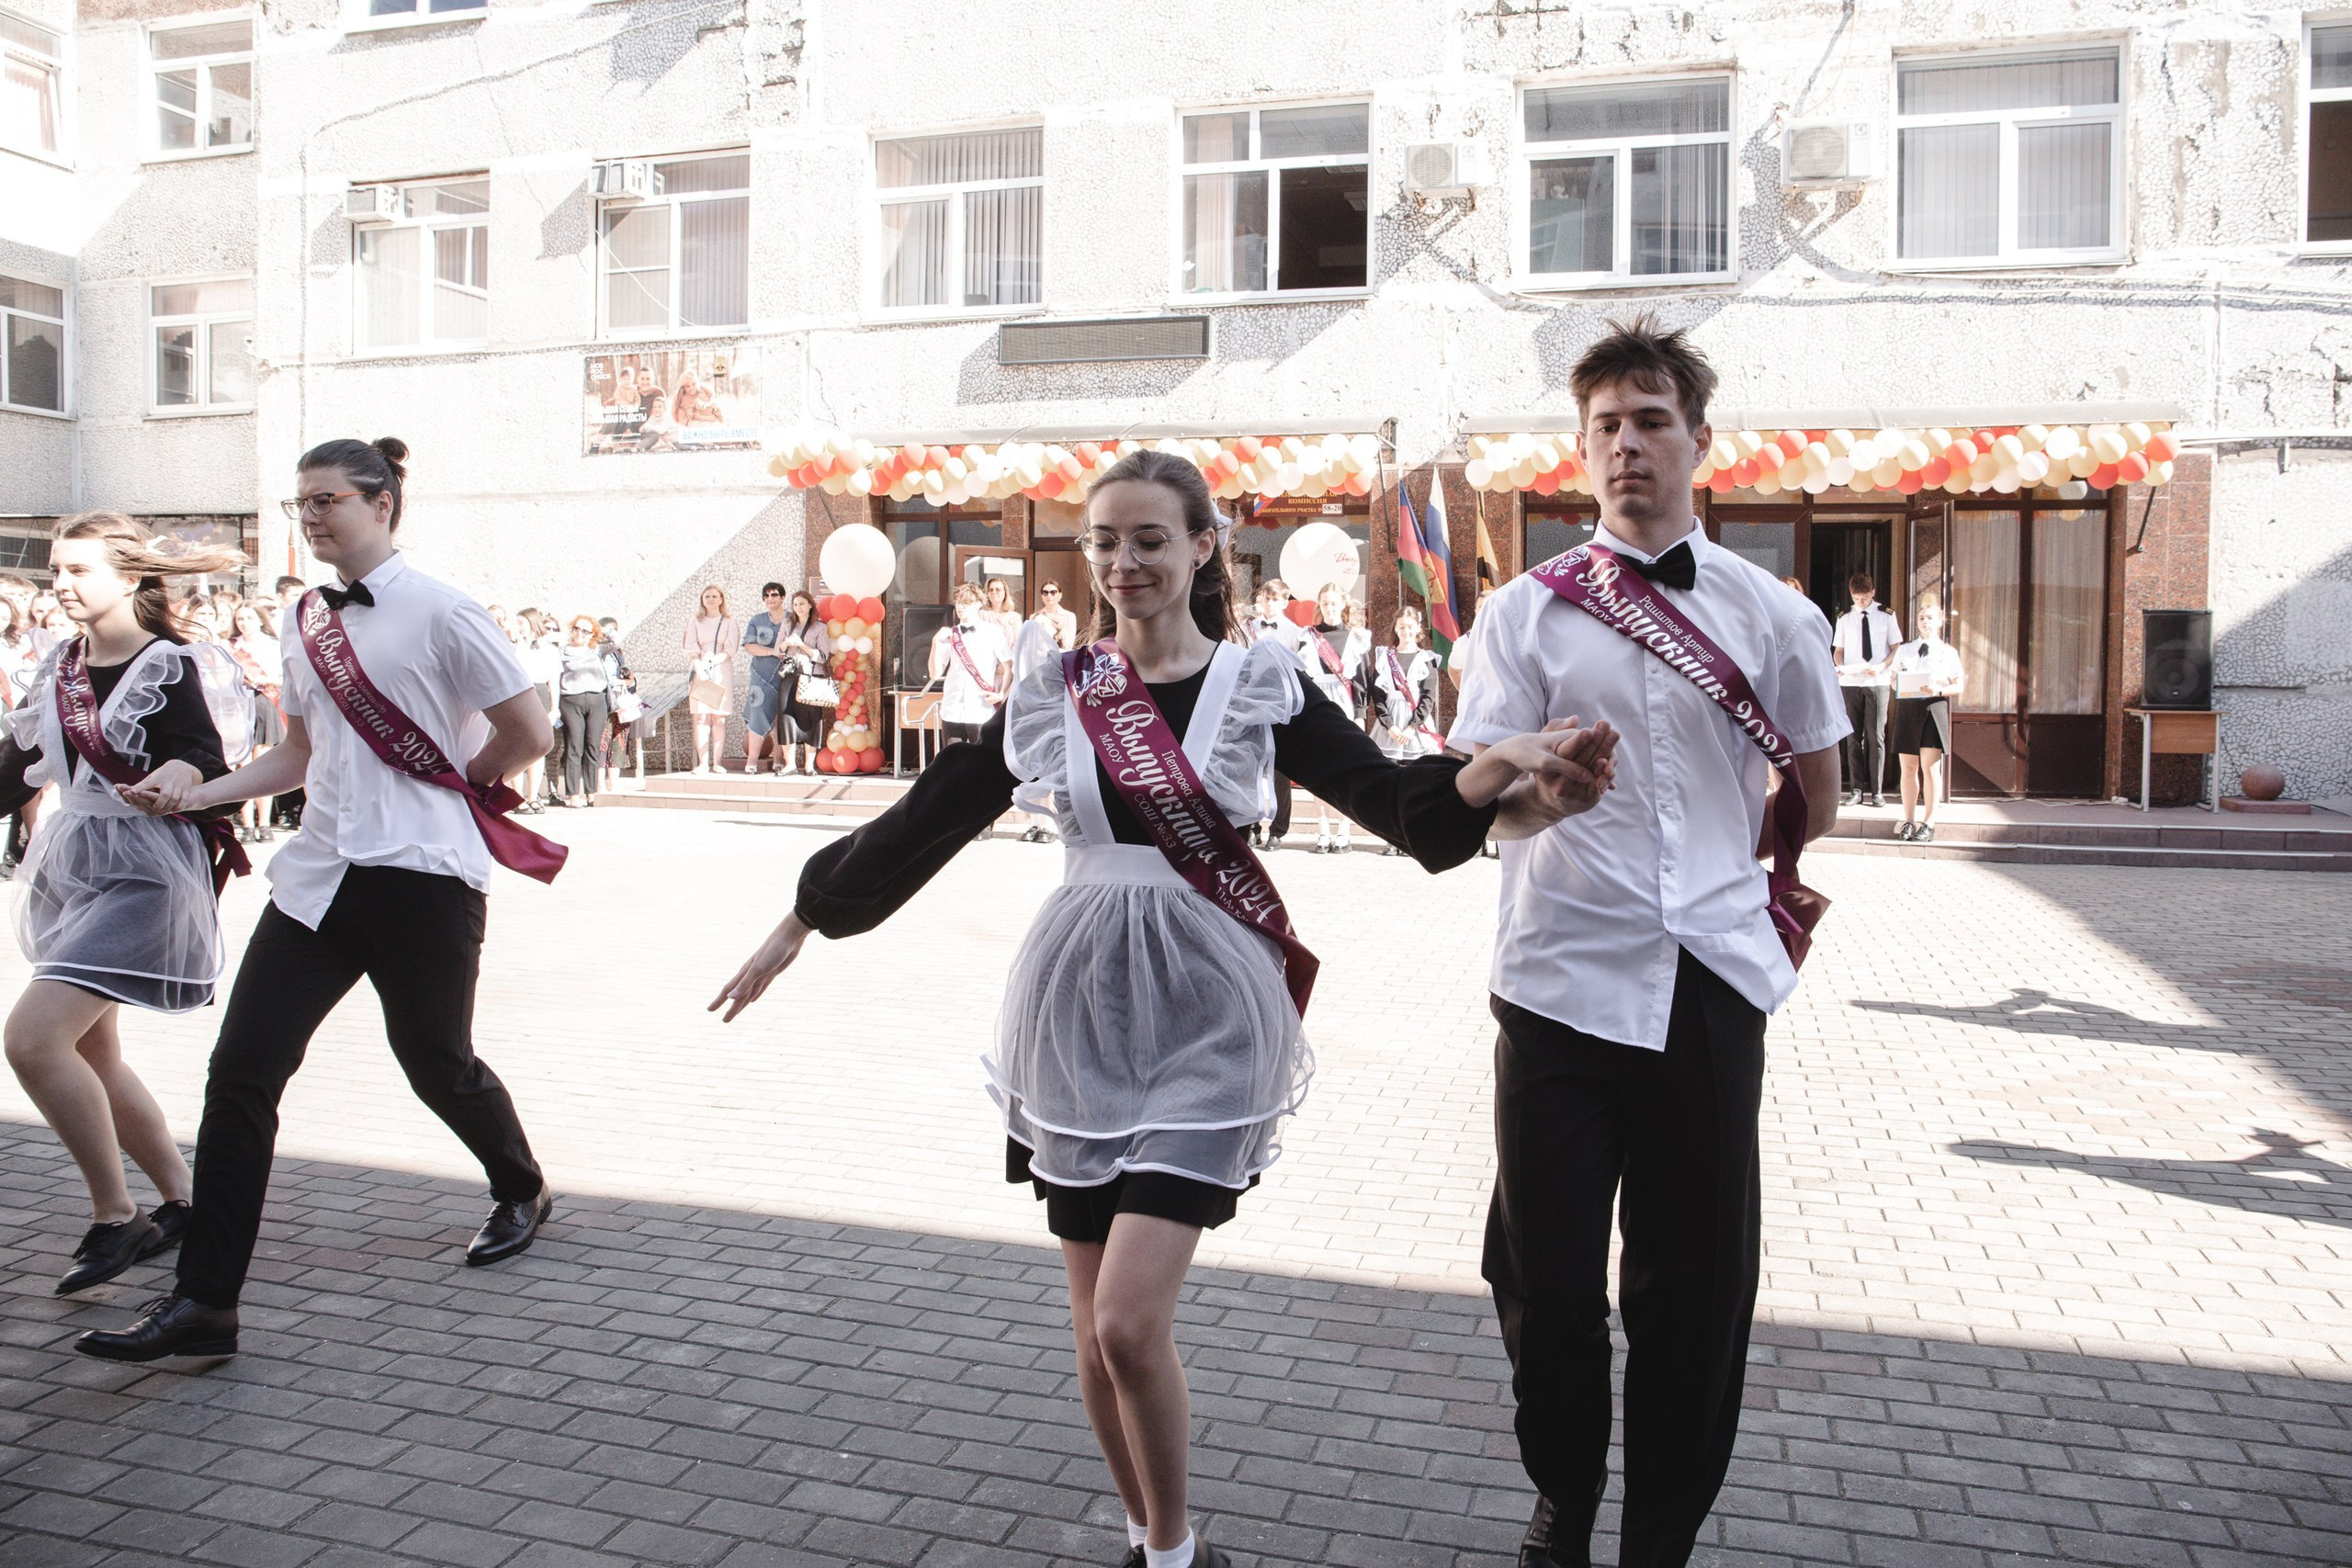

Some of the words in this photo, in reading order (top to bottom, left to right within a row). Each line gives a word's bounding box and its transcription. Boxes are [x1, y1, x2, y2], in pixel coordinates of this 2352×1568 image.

[1576, 558, 1727, 702] Выпускник
[1580, 597, 1611, 624] МАОУ
[1638, 594, 1683, 635] Рашитов
[1680, 633, 1714, 665] Артур
[62, 694, 72, 713] МАОУ
[313, 655, 329, 676] МАОУ
[335, 692, 350, 713] СОШ
[315, 628, 395, 739] Выпускник
[1099, 732, 1125, 765] МАОУ
[1134, 793, 1158, 822] СОШ
[1154, 820, 1177, 850] №33
[1105, 700, 1220, 863] Выпускница
[1216, 859, 1282, 924] 2024
[1161, 750, 1193, 796] Петрова
[1190, 795, 1217, 829] Алина
